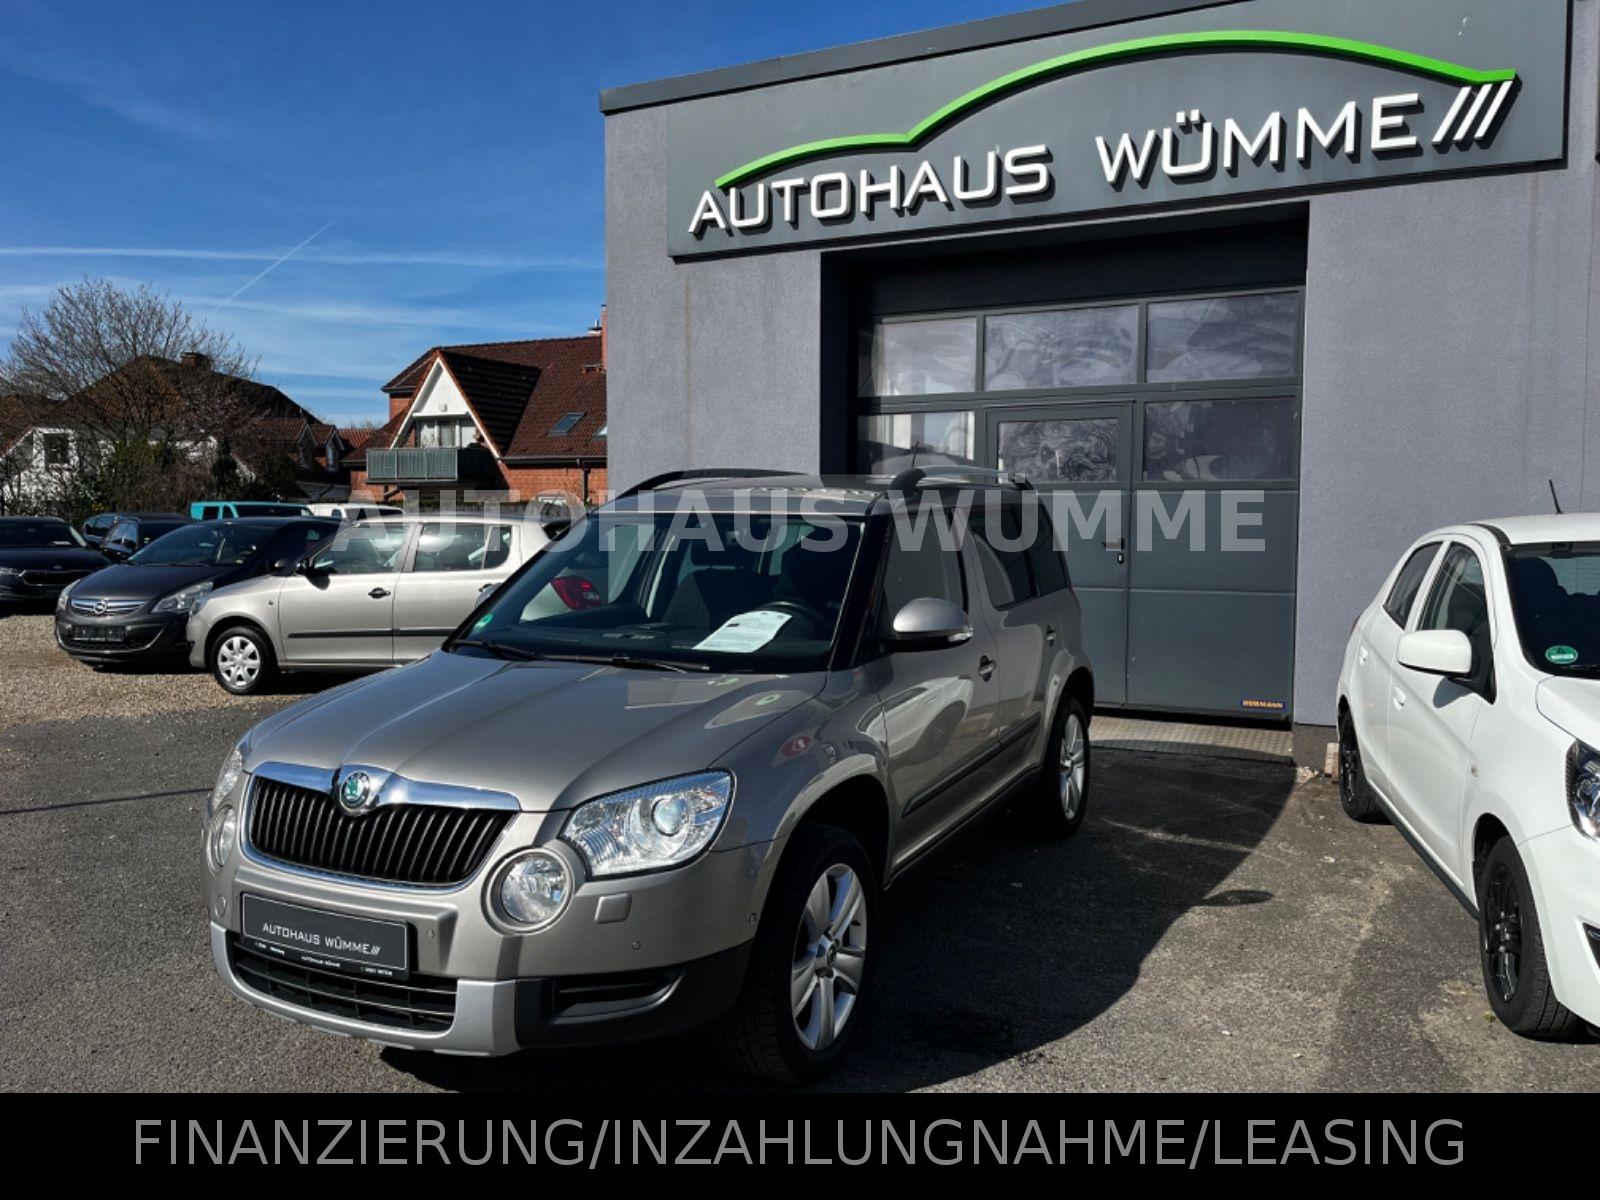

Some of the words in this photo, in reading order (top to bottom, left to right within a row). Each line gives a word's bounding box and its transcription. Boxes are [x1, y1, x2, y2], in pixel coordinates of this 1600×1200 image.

[687, 144, 1050, 234] AUTOHAUS
[1095, 92, 1420, 185] WÜMME
[261, 922, 321, 946] AUTOHAUS
